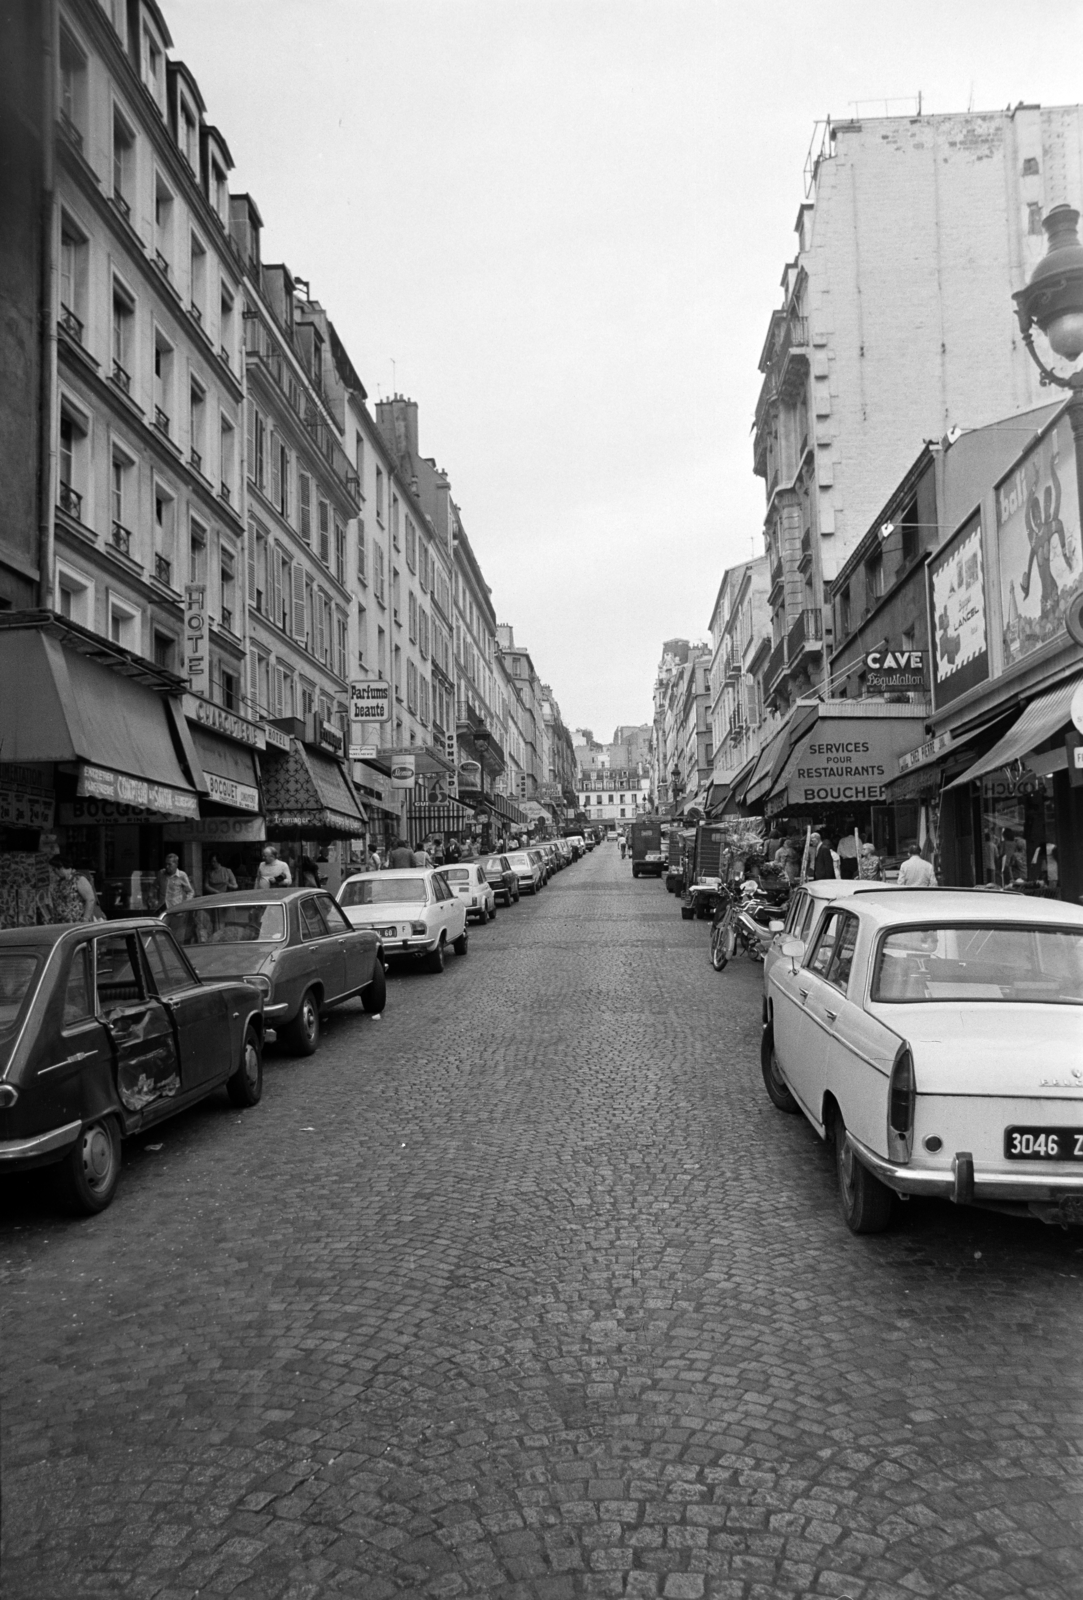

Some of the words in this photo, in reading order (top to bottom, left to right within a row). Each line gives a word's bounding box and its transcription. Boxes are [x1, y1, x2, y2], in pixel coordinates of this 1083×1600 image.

[954, 606, 979, 631] LANCEL
[187, 592, 204, 696] HOTEL
[867, 652, 923, 669] CAVE
[867, 672, 924, 690] Dégustation
[351, 685, 388, 700] Parfums
[354, 703, 384, 718] beauté
[809, 742, 869, 754] SERVICES
[797, 765, 884, 778] RESTAURANTS
[210, 777, 238, 799] BOCQUET
[1011, 1133, 1058, 1156] 3046
